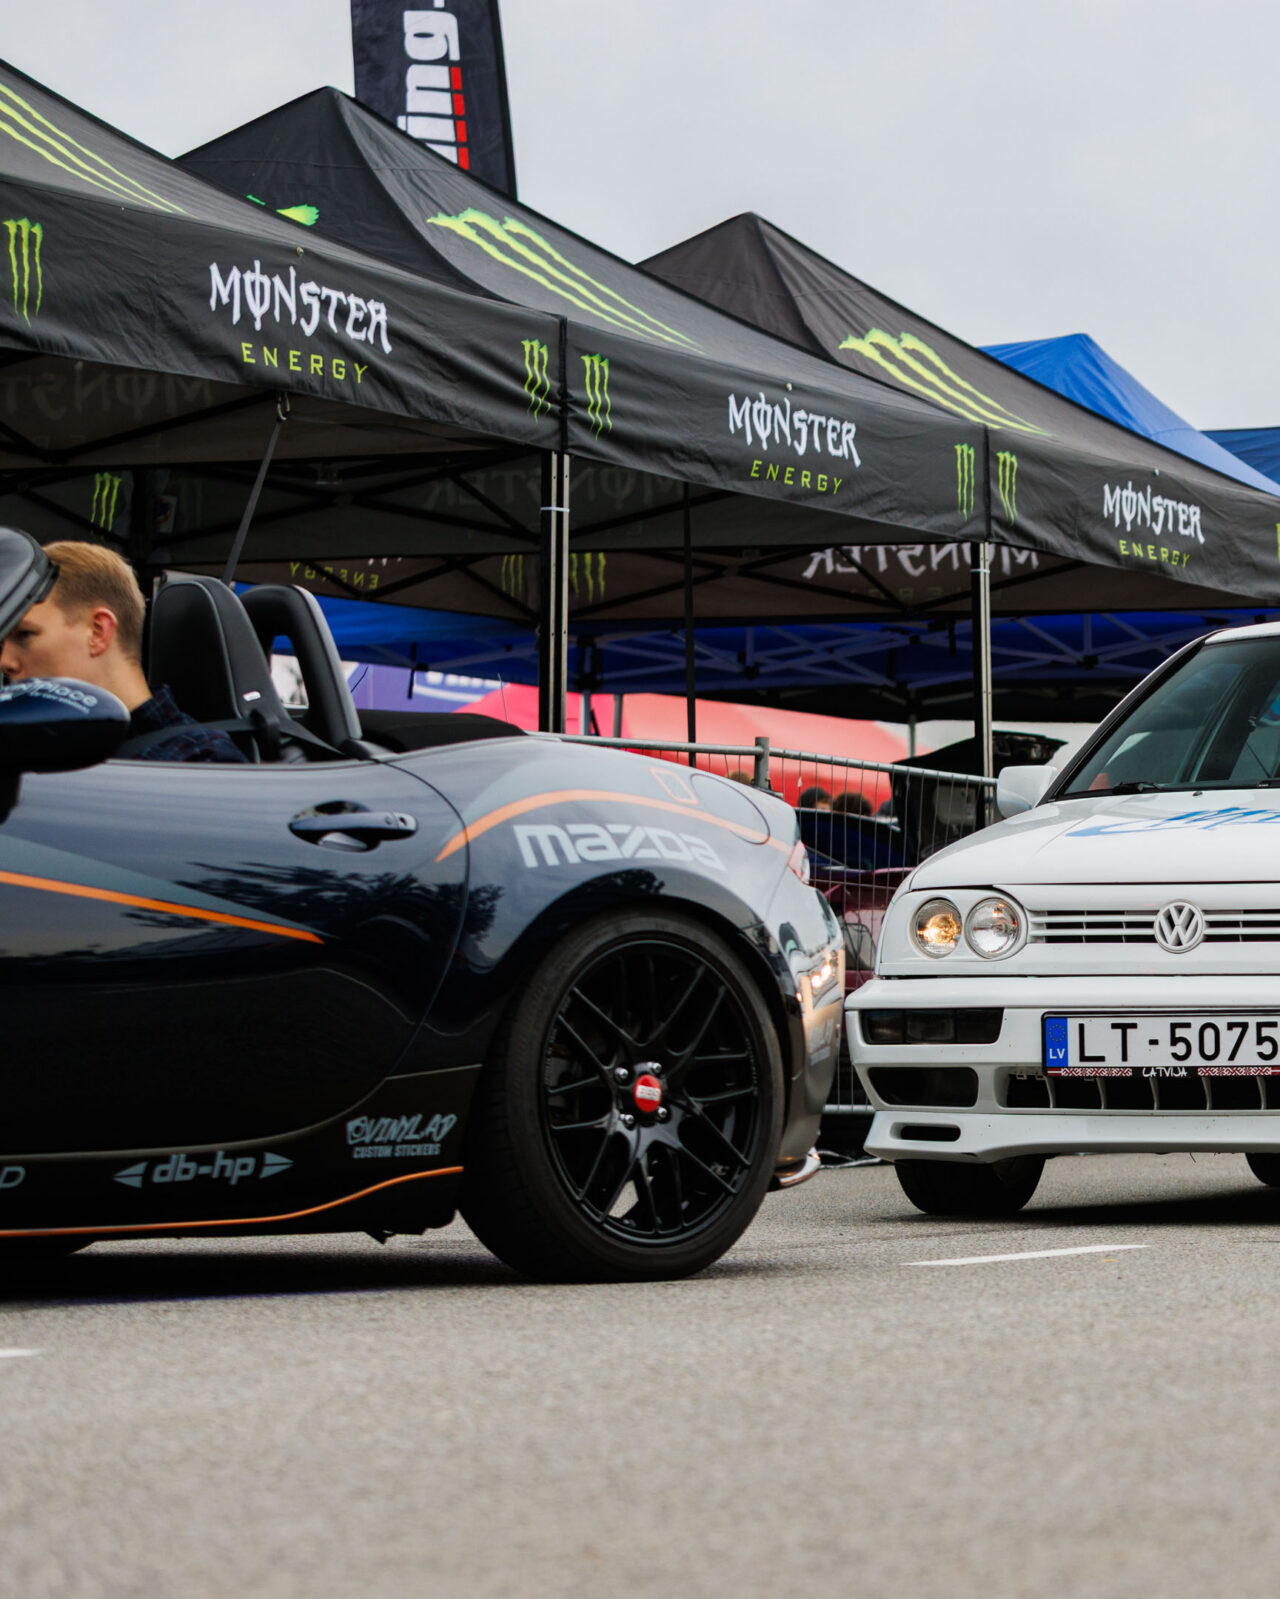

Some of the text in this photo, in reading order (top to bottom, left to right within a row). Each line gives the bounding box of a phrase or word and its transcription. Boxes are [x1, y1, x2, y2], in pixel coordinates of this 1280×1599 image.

[209, 259, 393, 355] MONSTER
[241, 342, 368, 384] ENERGY
[728, 391, 861, 468] MONSTER
[750, 459, 842, 495] ENERGY
[1103, 481, 1205, 544] MONSTER
[1119, 539, 1190, 568] ENERGY
[1049, 1048, 1066, 1060] LV
[1078, 1021, 1279, 1062] LT-5075
[1142, 1067, 1188, 1078] LATVIJA
[152, 1150, 256, 1186] db-hp
[394, 1143, 441, 1157] STICKERS
